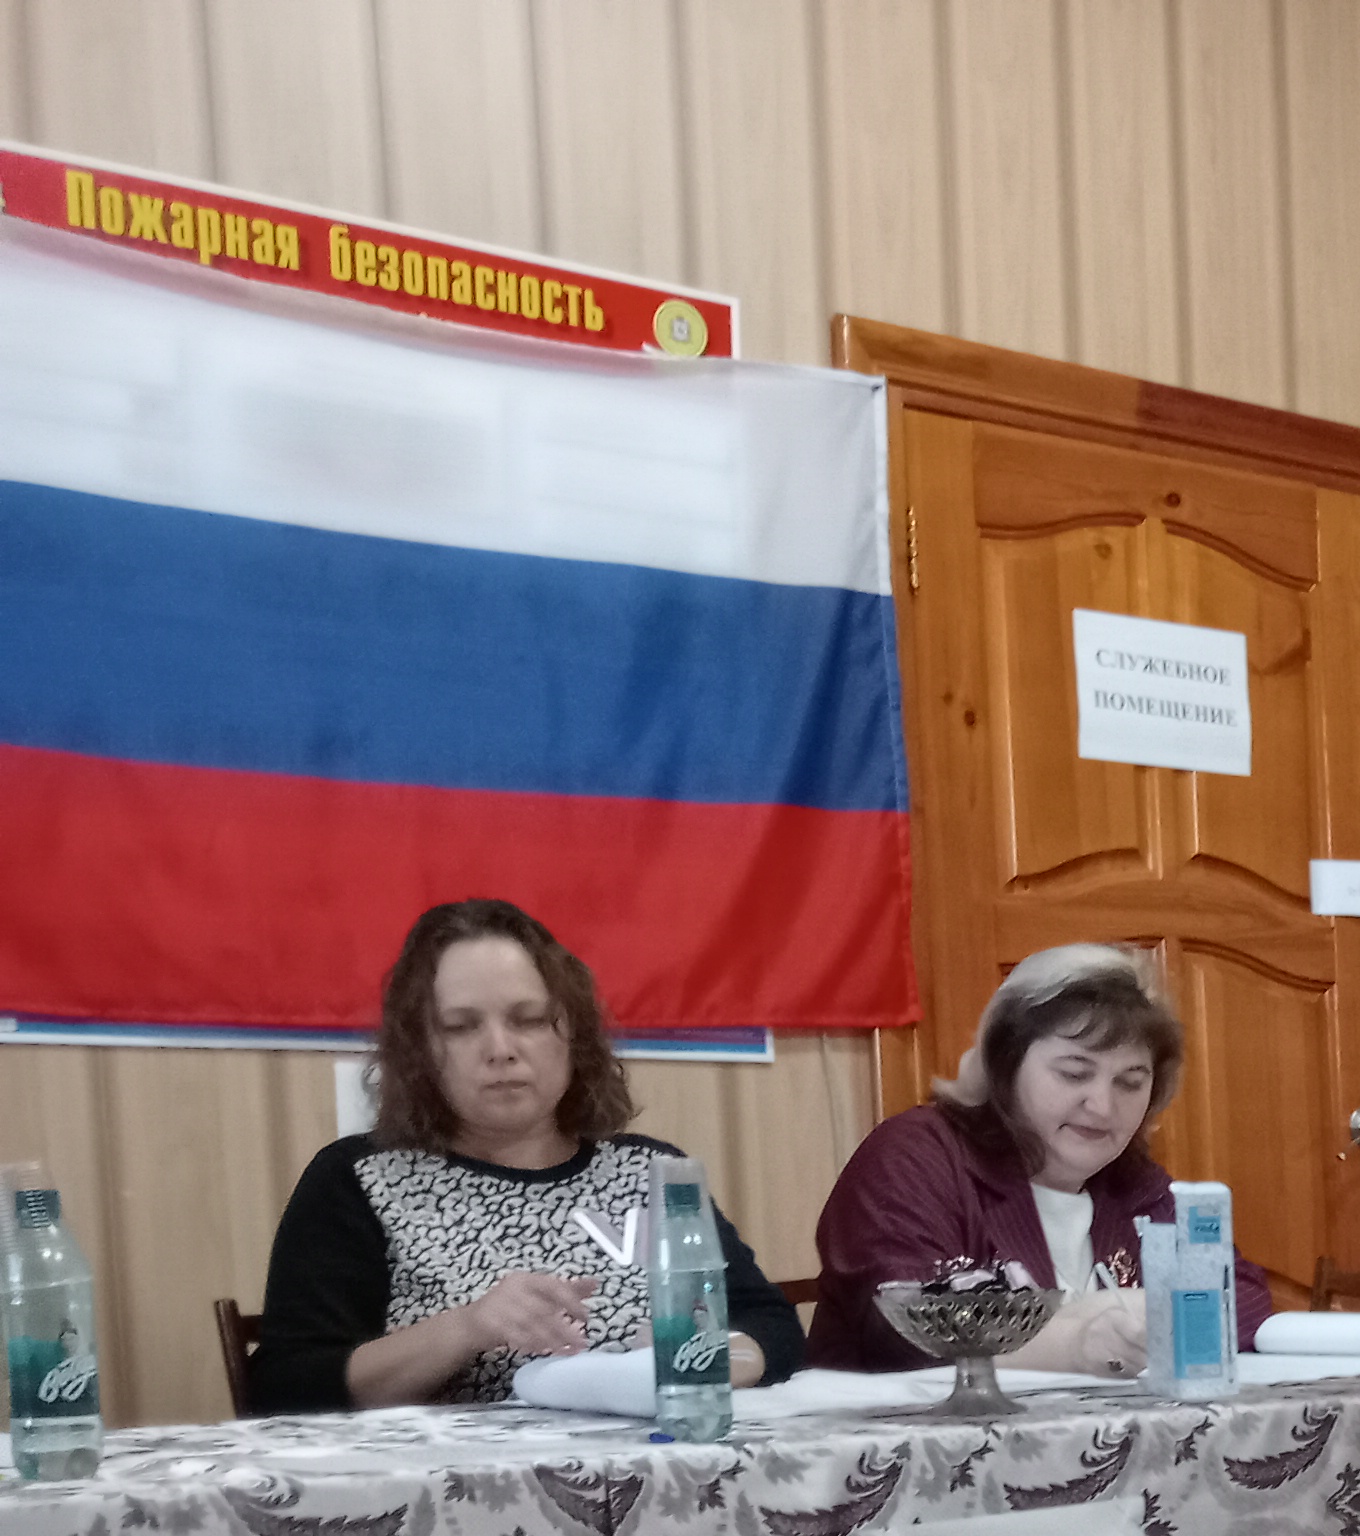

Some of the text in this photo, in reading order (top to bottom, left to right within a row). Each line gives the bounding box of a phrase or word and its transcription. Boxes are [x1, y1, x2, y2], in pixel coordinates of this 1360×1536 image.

[65, 168, 606, 333] Пожарная безопасность
[1095, 648, 1232, 687] СЛУЖЕБНОЕ
[1094, 688, 1238, 728] ПОМЕЩЕНИЕ
